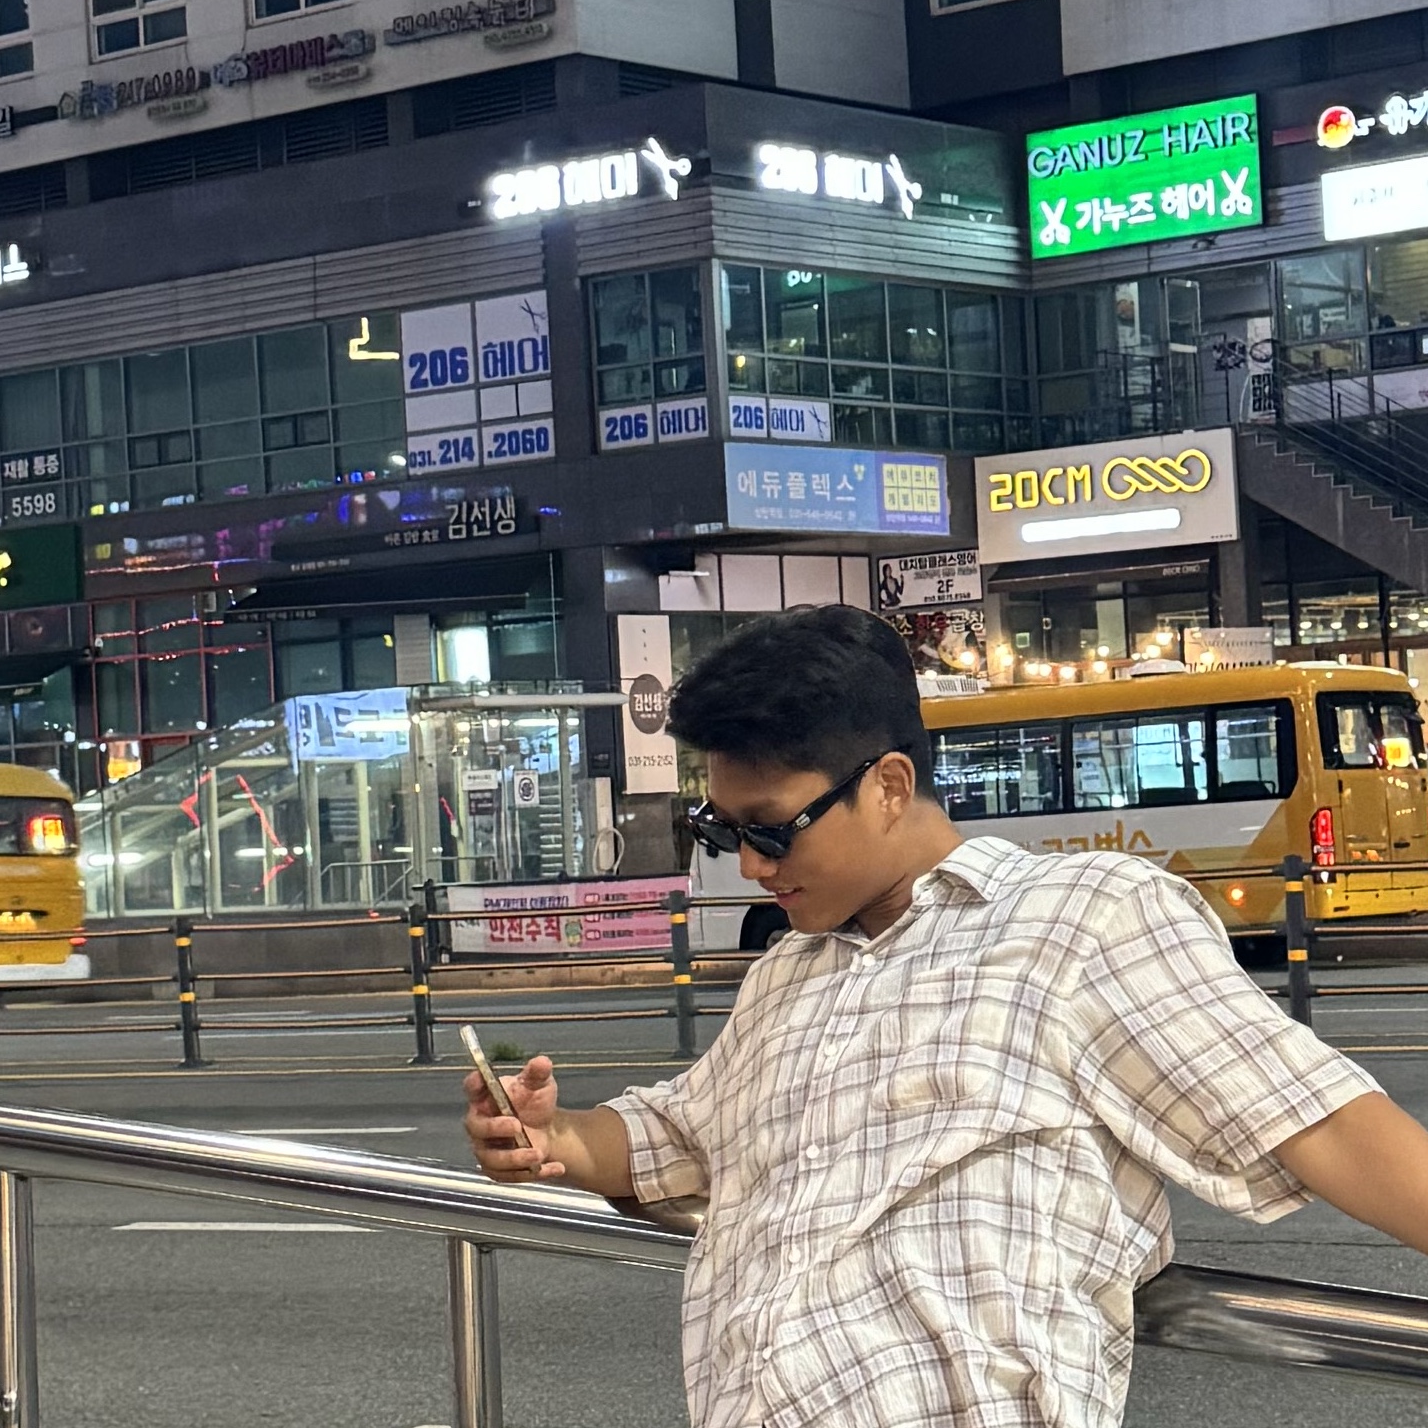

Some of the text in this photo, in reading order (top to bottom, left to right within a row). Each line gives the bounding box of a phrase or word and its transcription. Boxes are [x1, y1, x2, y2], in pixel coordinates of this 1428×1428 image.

[1028, 112, 1252, 178] GANUZ HAIR
[1075, 179, 1215, 234] 가누즈 헤어
[408, 334, 549, 390] 206 헤어
[604, 406, 707, 443] 206 헤어
[732, 404, 805, 433] 206 헤어
[737, 468, 856, 502] 에듀플렉스
[989, 464, 1092, 512] 20CM
[445, 494, 516, 540] 김선생
[937, 578, 955, 594] 2F
